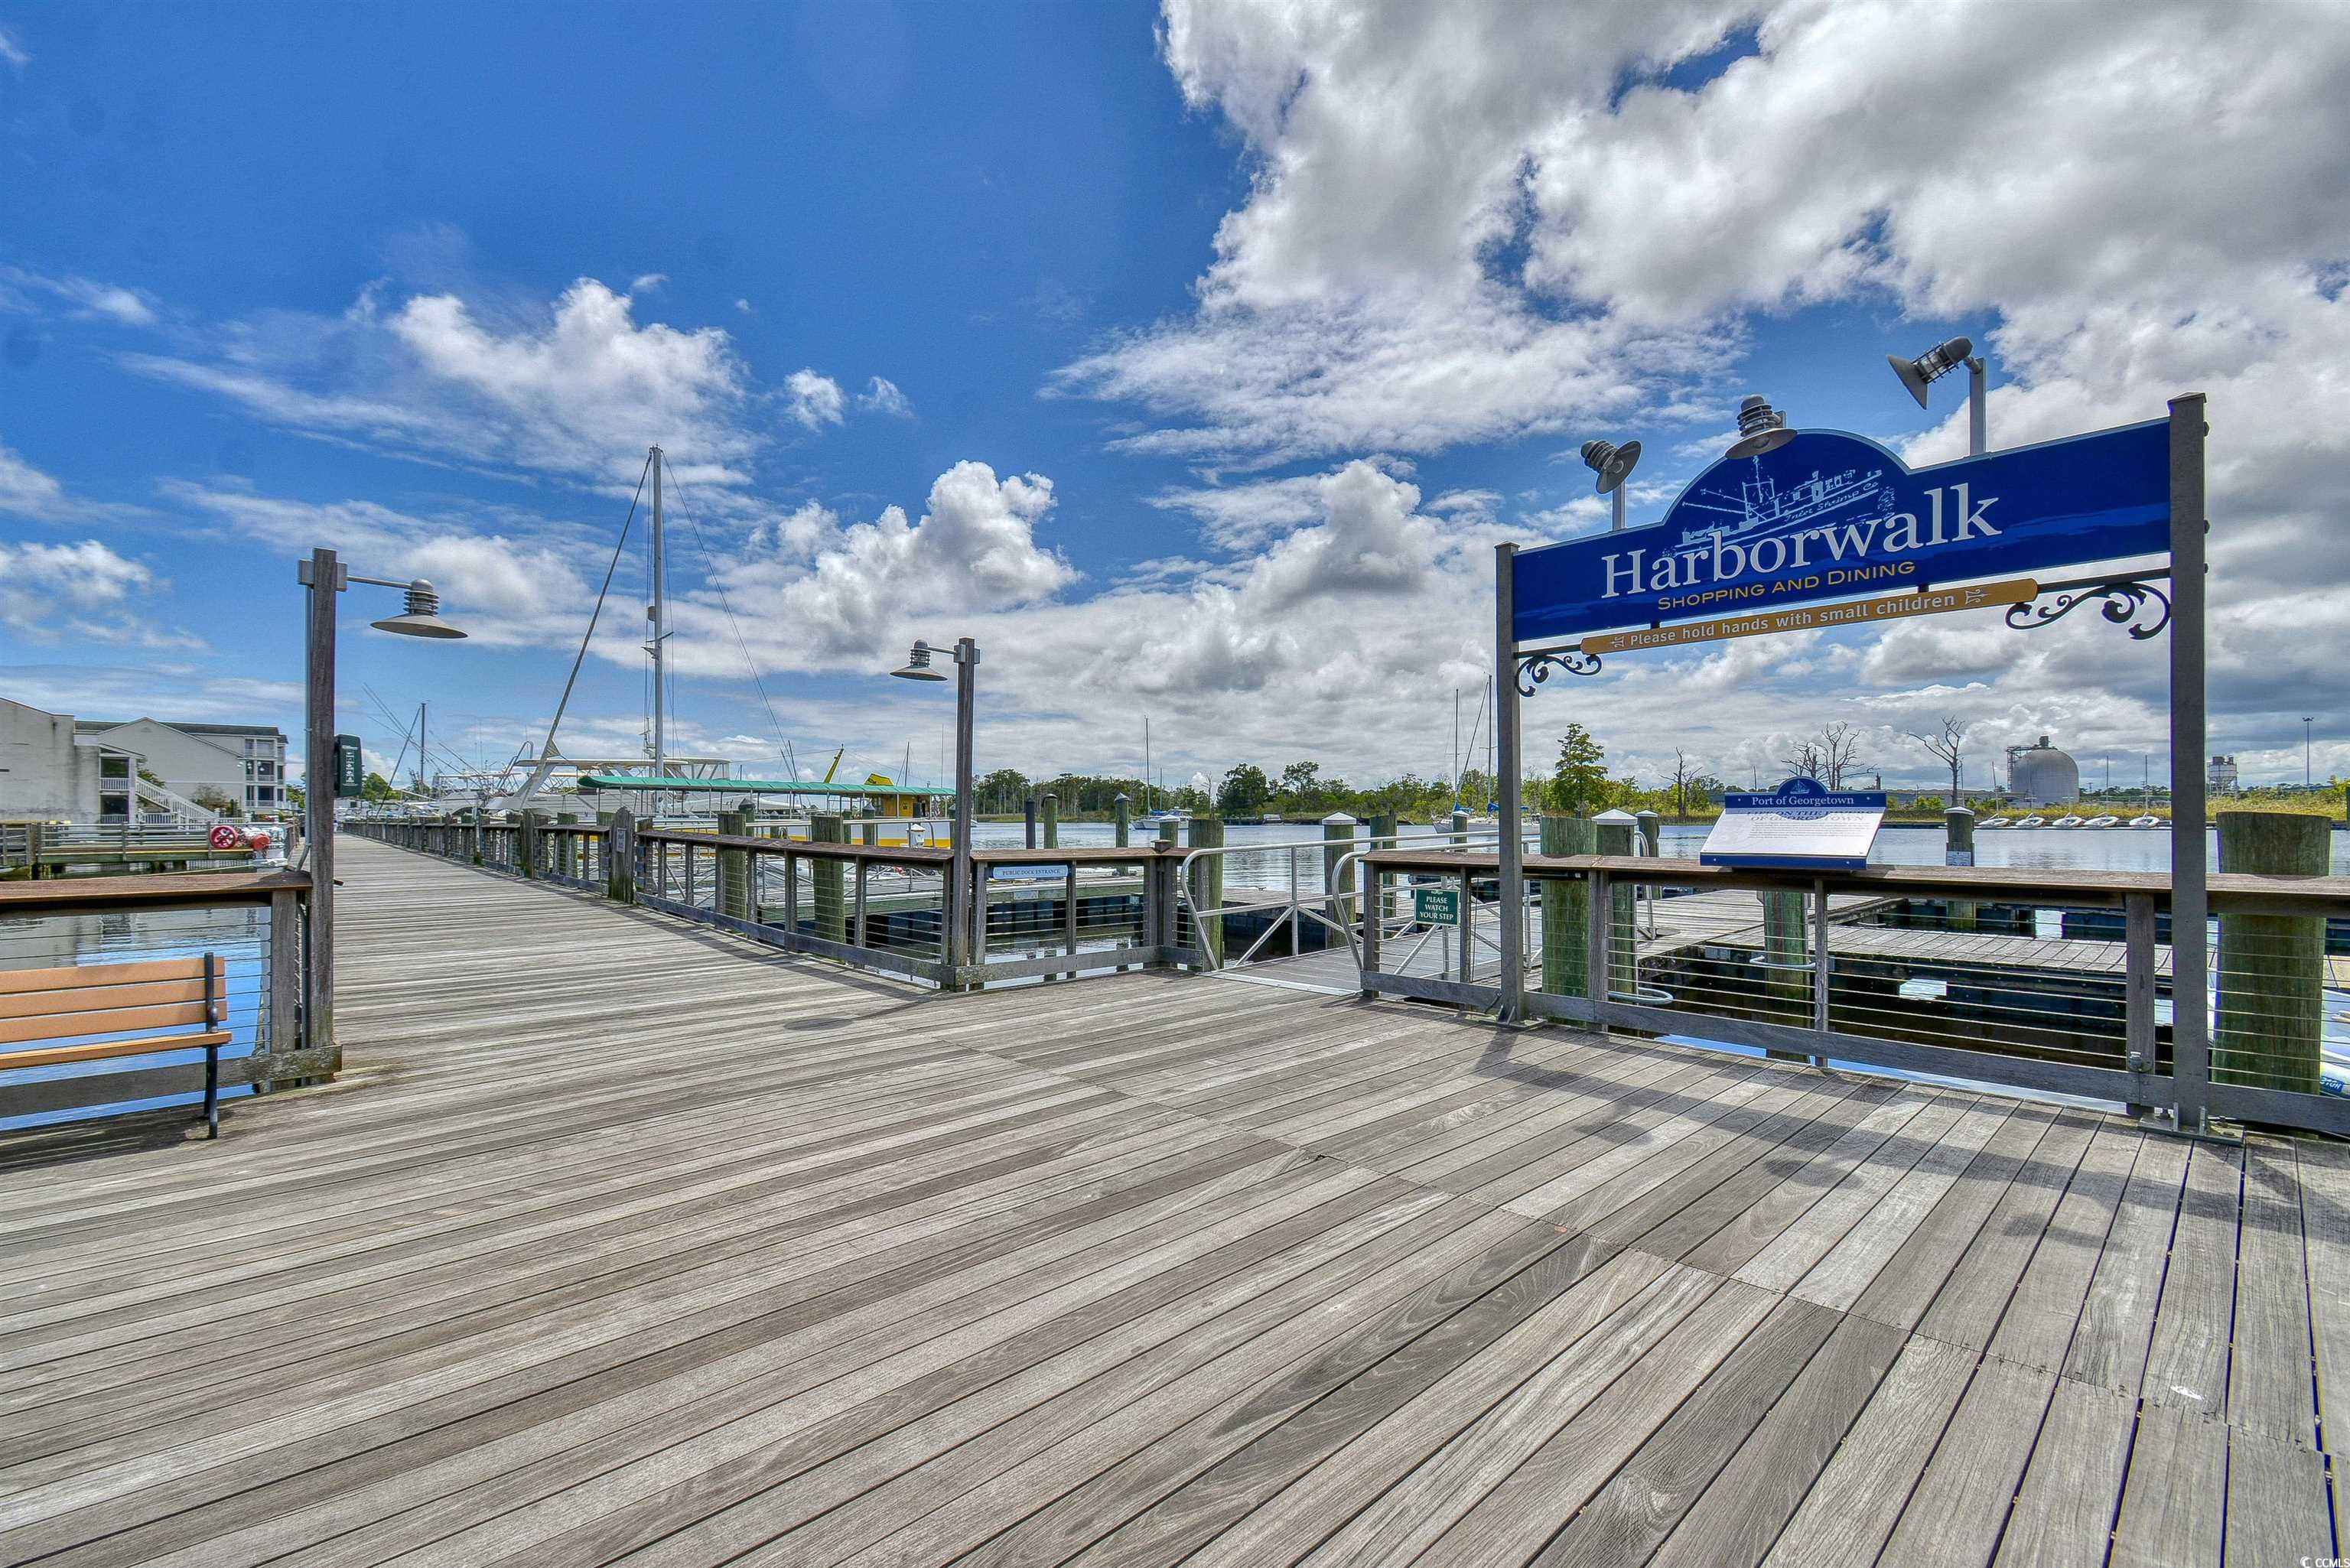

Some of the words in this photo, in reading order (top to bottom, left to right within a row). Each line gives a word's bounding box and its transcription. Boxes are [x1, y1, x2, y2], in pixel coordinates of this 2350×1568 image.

[1818, 491, 1860, 510] Shrimp
[1601, 483, 2002, 599] Harborwalk
[1658, 584, 1766, 610] SHOPPING
[1771, 576, 1820, 594] AND
[1828, 561, 1915, 585] DINING
[1630, 629, 1676, 646] Please
[1682, 624, 1715, 639] hold
[1722, 618, 1769, 634] hands
[1776, 612, 1812, 628] with
[1819, 604, 1868, 623] small
[1876, 594, 1955, 615] children
[1752, 796, 1773, 805] Port
[1776, 795, 1788, 805] of
[1789, 795, 1854, 807] Georgetown
[1424, 904, 1448, 912] WATCH
